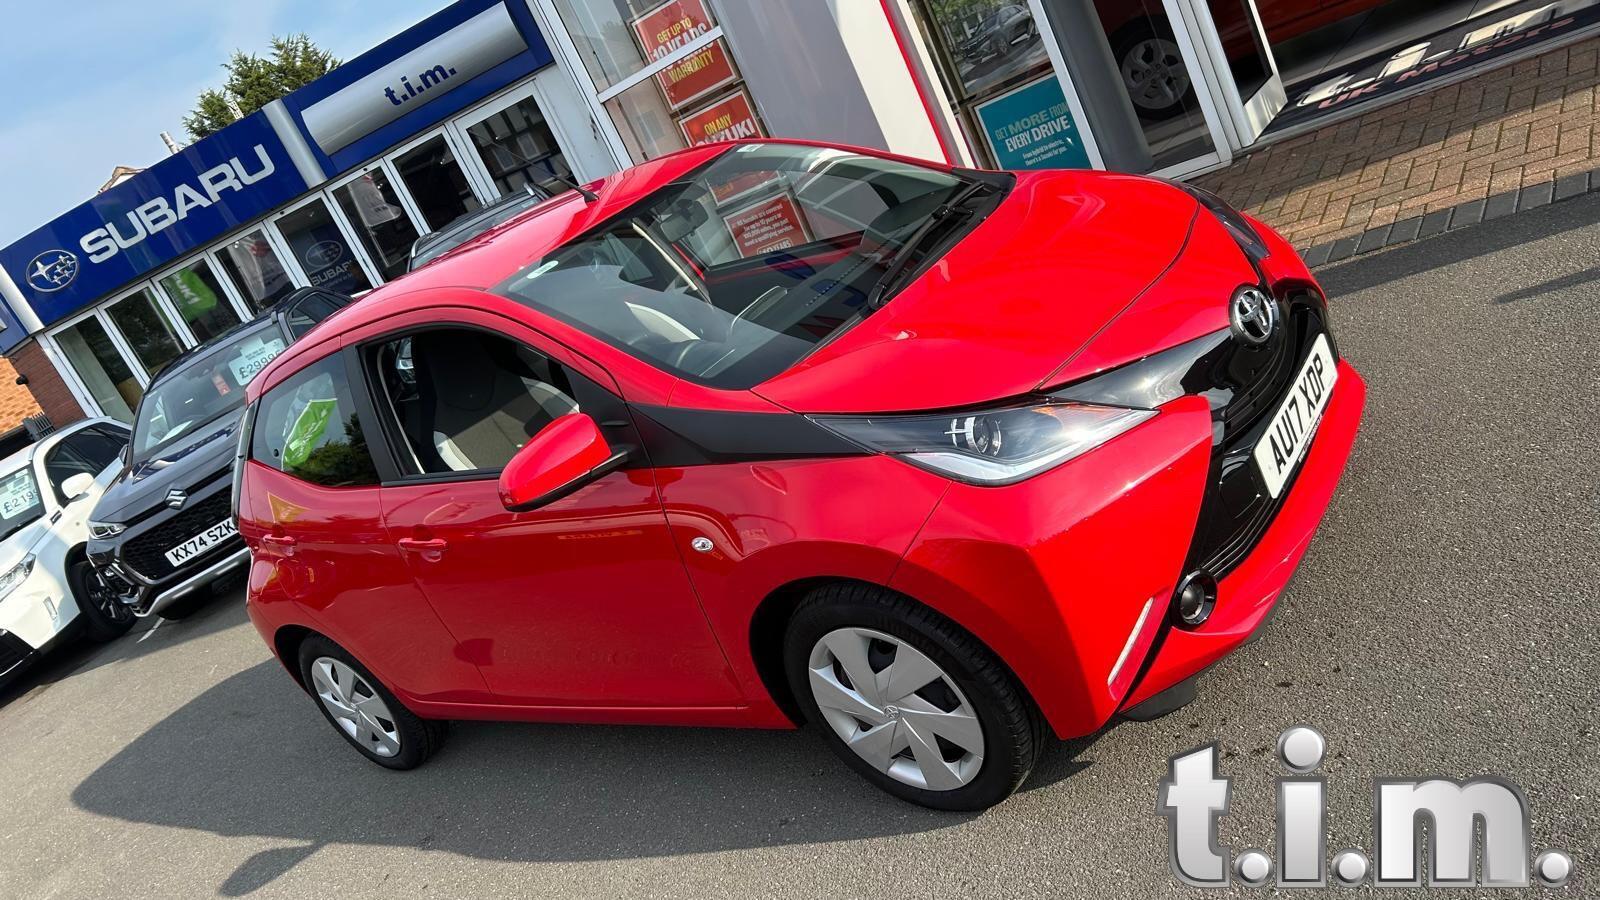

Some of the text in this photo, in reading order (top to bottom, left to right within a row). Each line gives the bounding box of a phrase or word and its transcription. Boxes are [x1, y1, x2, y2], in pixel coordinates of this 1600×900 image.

[656, 17, 692, 43] GET UP TO
[667, 49, 714, 83] WARRANTY
[384, 64, 457, 106] t.i.m.
[704, 113, 733, 136] ON ANY
[994, 126, 1009, 140] GET
[1007, 110, 1050, 135] MORE
[1005, 115, 1071, 153] EVERY DRIVE
[79, 143, 276, 264] SUBARU
[310, 260, 352, 286] SUBAR
[1269, 395, 1304, 475] AU17
[1298, 352, 1325, 419] XDP
[171, 520, 236, 562] KX74 SZK
